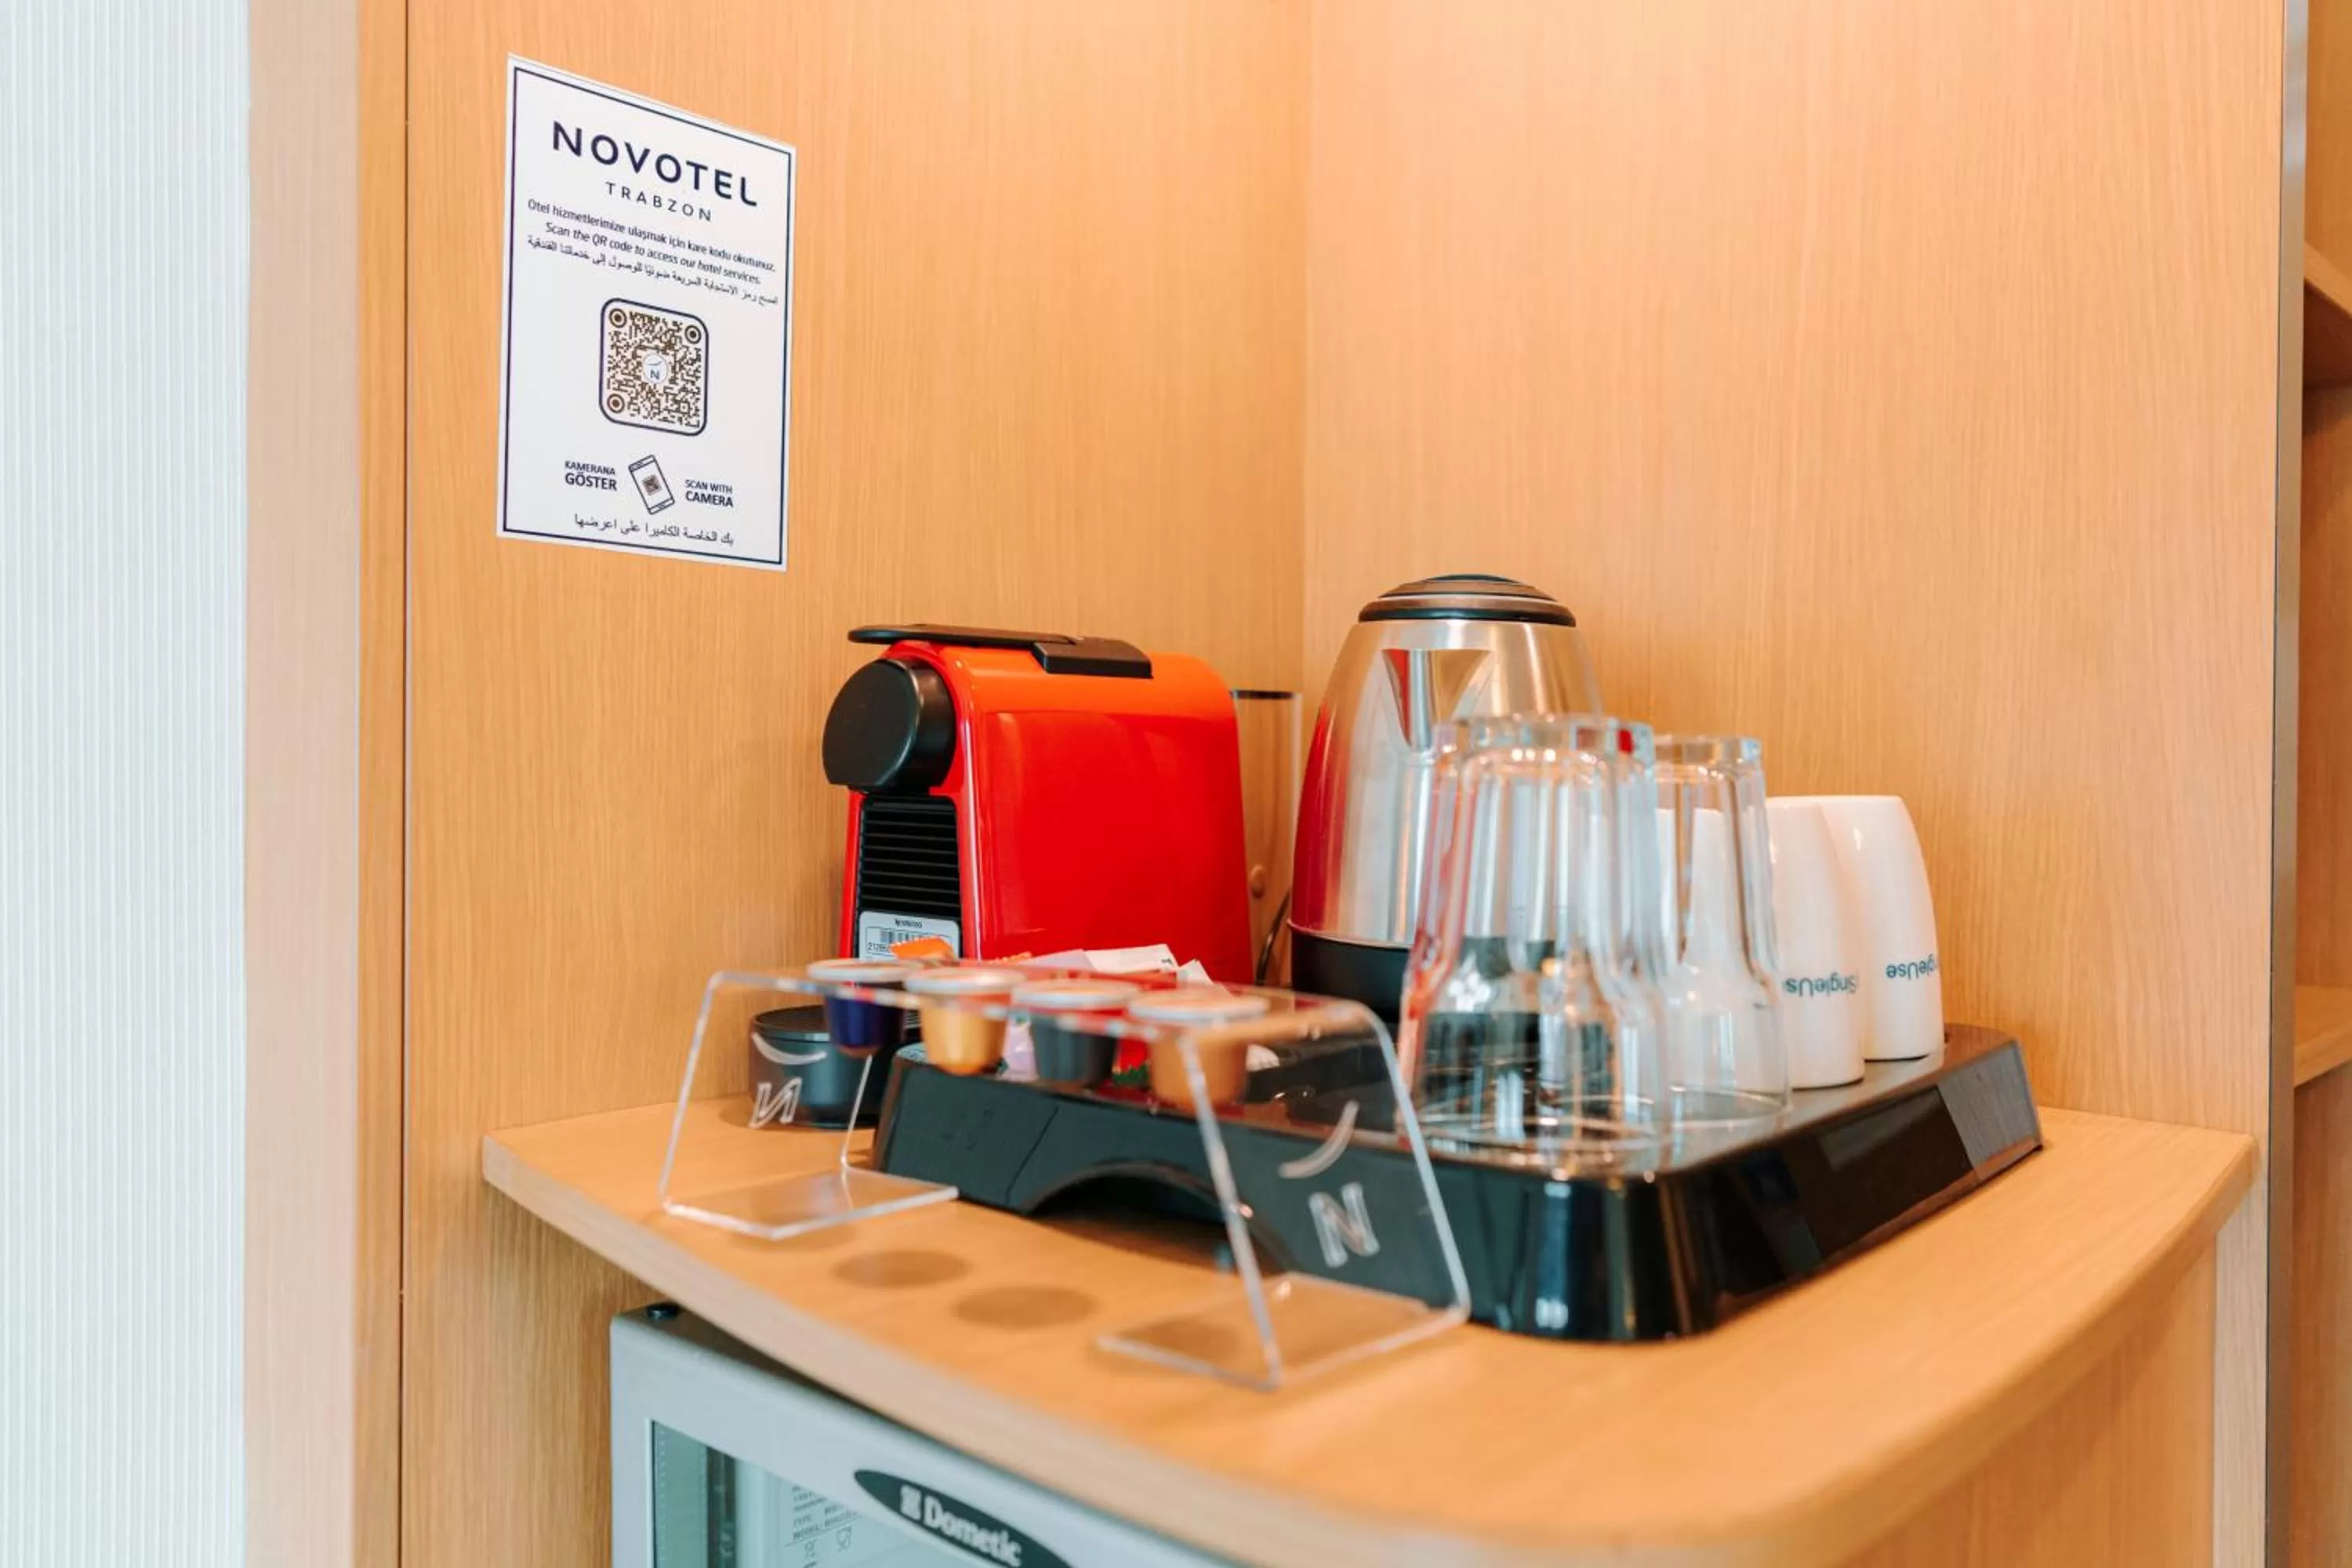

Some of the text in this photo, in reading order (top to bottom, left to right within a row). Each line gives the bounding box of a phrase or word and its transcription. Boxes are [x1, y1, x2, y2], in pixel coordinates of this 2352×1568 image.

[553, 121, 757, 206] NOVOTEL
[605, 181, 712, 222] TRABZON
[528, 198, 776, 271] Otel hizmetlerimize ulaşmak için kare kodu okutunuz.
[546, 222, 760, 285] Scan the QR code to access our hotel services.
[650, 369, 660, 380] N
[564, 460, 615, 475] KAMERANA
[564, 472, 618, 491] GÖSTER
[685, 479, 732, 493] SCAN WITH
[685, 491, 733, 507] CAMERA
[924, 1495, 1022, 1567] Dometic
